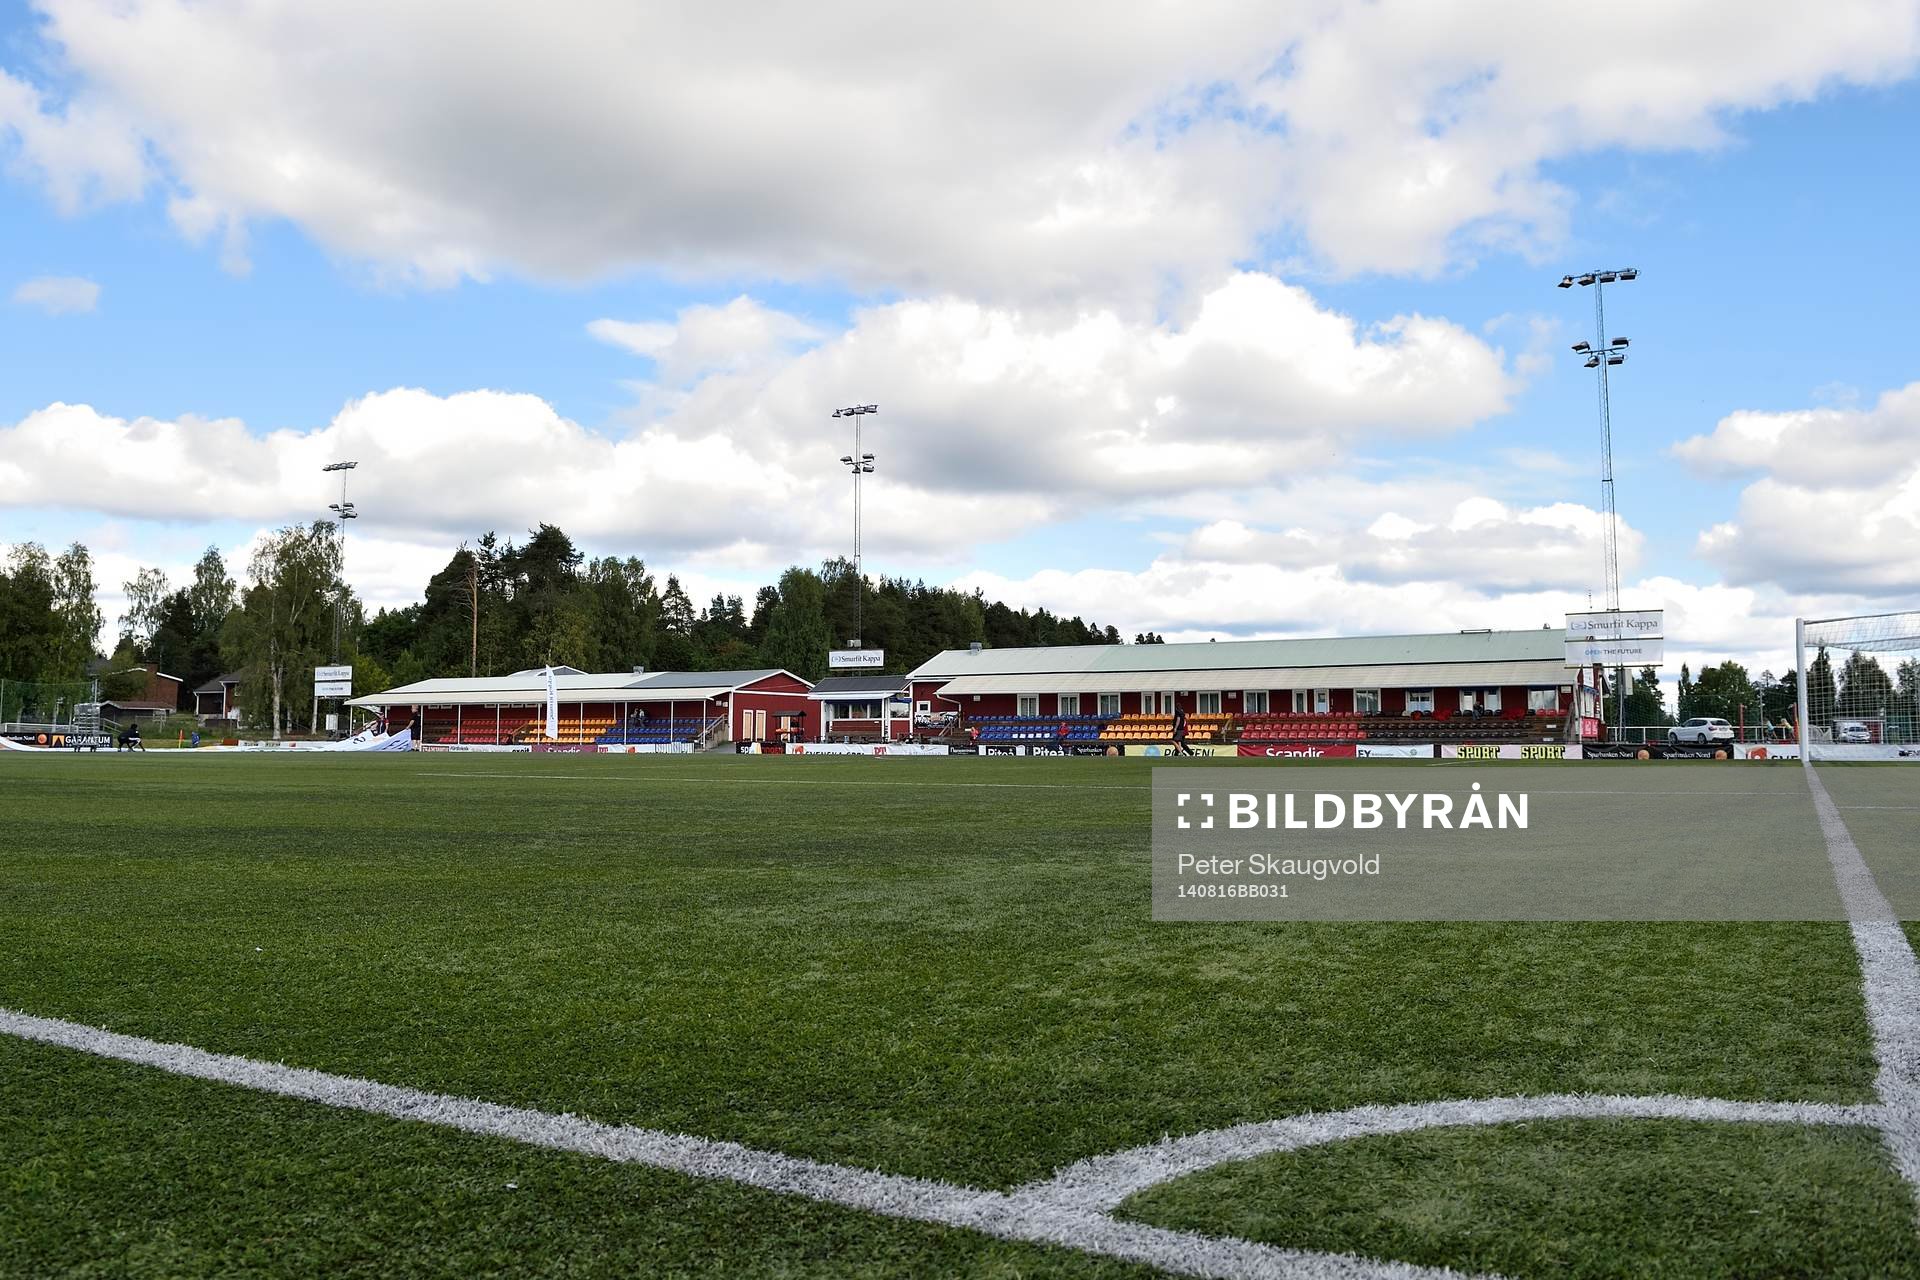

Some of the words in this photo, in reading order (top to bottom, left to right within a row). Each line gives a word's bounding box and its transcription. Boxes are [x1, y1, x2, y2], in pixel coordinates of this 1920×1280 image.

[1588, 619, 1624, 630] Smurfit
[1626, 619, 1658, 631] Kappa
[841, 655, 862, 663] Smurfit
[862, 655, 881, 664] Kappa
[1265, 747, 1325, 757] Scandic
[1457, 745, 1500, 759] SPORT
[1521, 745, 1566, 760] SPORT
[1587, 751, 1619, 759] Sparbanken
[1662, 751, 1694, 760] Sparbanken
[1695, 751, 1711, 759] Nord
